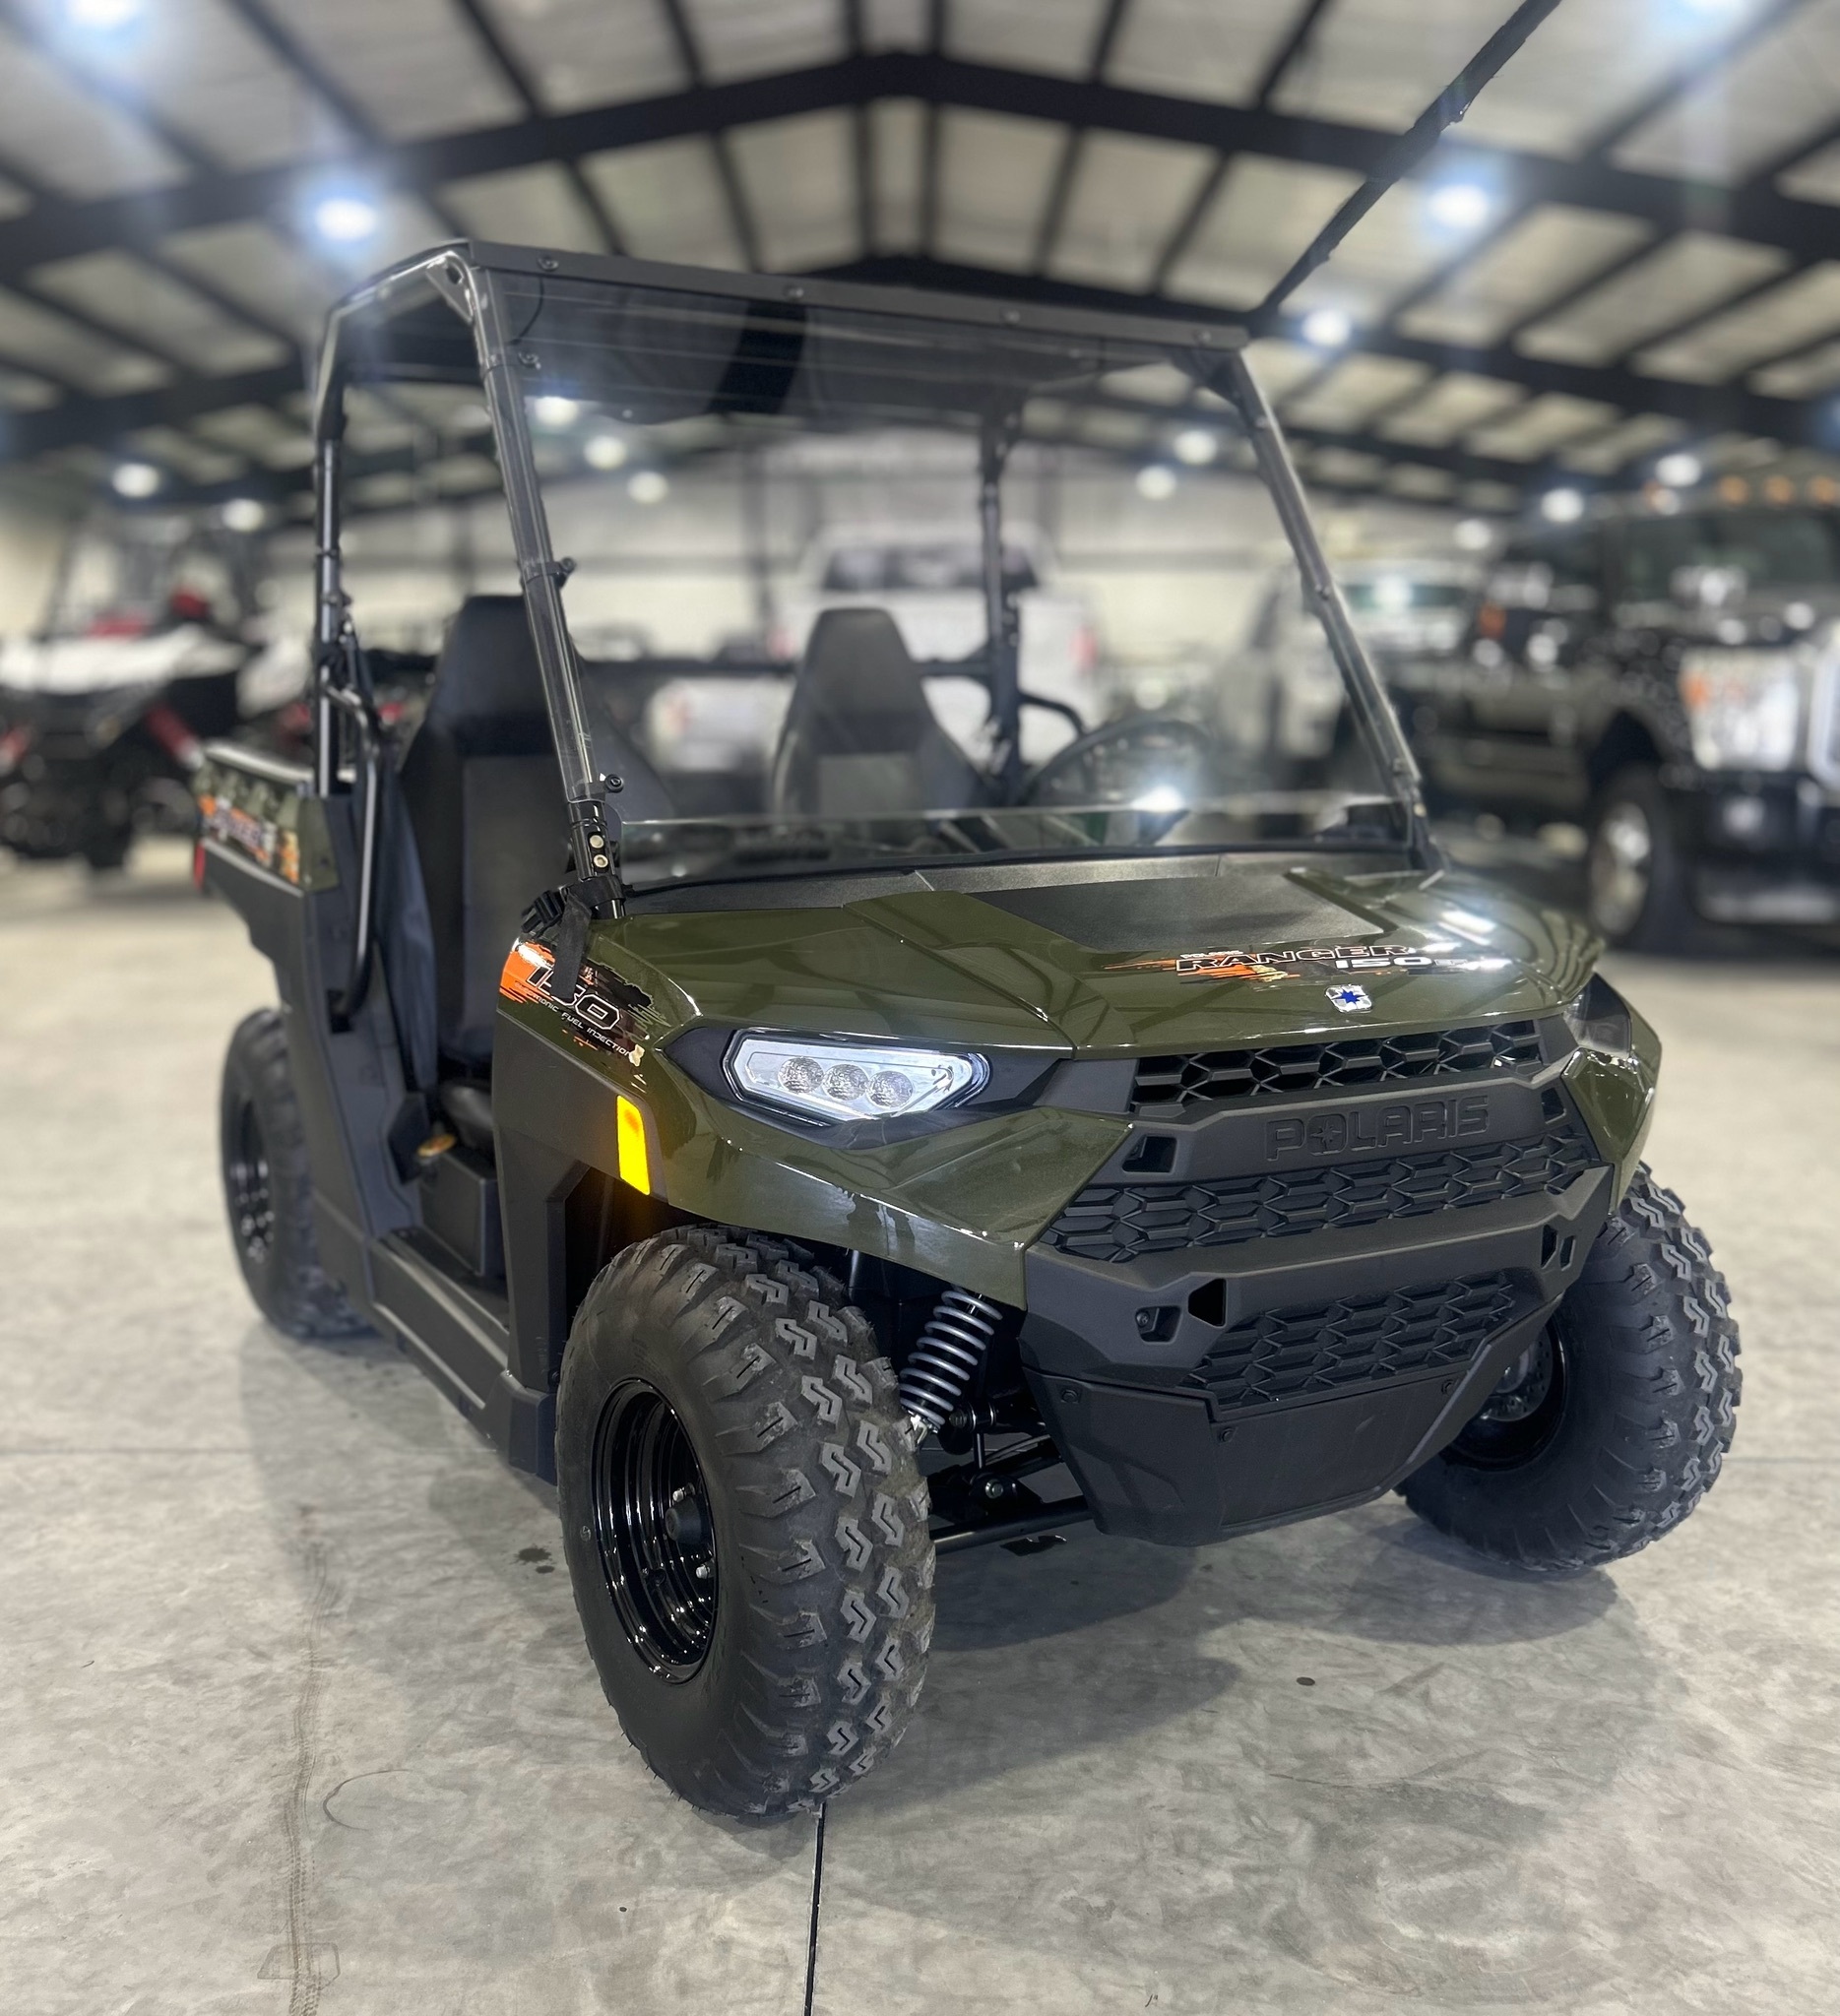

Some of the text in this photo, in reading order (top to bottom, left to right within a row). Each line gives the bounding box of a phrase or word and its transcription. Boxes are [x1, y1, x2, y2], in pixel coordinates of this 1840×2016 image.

[1176, 944, 1416, 972] RANGER
[1335, 956, 1432, 969] 150
[561, 1012, 584, 1030] FUEL
[1266, 1095, 1490, 1162] POLARIS
